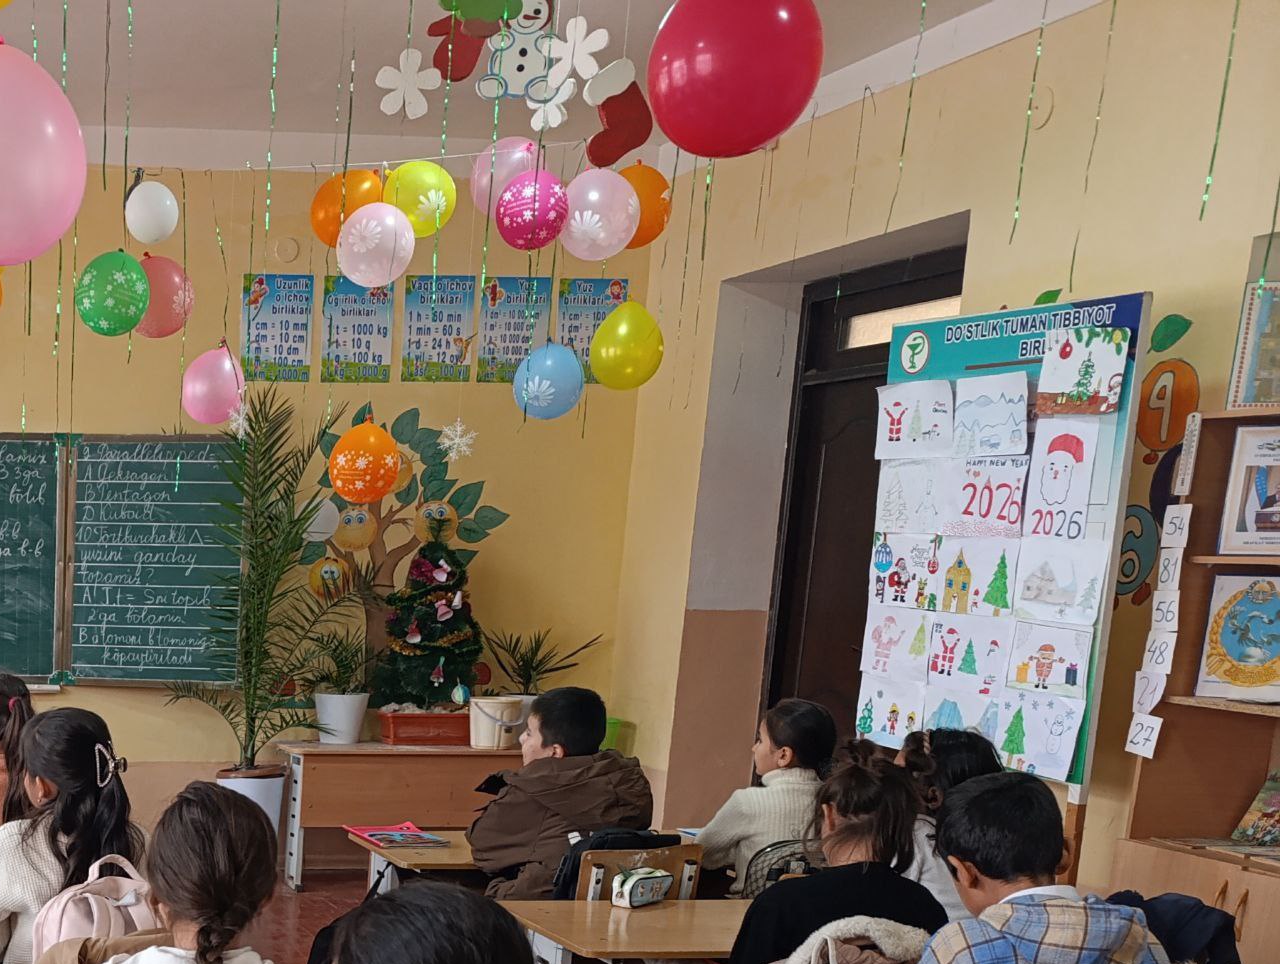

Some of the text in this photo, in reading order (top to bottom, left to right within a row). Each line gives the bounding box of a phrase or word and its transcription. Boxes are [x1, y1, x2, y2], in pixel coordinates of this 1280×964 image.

[275, 280, 310, 290] Uzunlik
[576, 281, 593, 292] Yuz
[564, 295, 604, 305] birliklari
[272, 305, 312, 315] birliklari
[341, 307, 377, 316] birliklari
[447, 311, 462, 322] min
[279, 321, 290, 331] 10
[945, 304, 1115, 343] DO'STLIK TUMAN TIBBIYOT
[352, 324, 388, 337] 1000 kg
[416, 325, 431, 336] min
[442, 325, 453, 336] 60
[279, 332, 290, 343] 10
[293, 332, 305, 343] cm
[352, 338, 362, 350] 10
[432, 338, 442, 349] 24
[445, 338, 451, 349] h
[273, 345, 299, 356] 10 dm
[273, 356, 304, 367] 100 cm
[353, 352, 368, 364] 100
[372, 352, 383, 364] kg
[437, 352, 447, 364] 12
[989, 459, 1007, 467] NEW
[961, 482, 1021, 525] 2026
[1031, 509, 1083, 540] 2026
[1165, 516, 1185, 535] 54
[1159, 556, 1178, 583] 81
[1154, 601, 1175, 623] 56
[1148, 639, 1168, 665] 48
[1136, 676, 1157, 706] 21
[1129, 722, 1154, 747] 27
